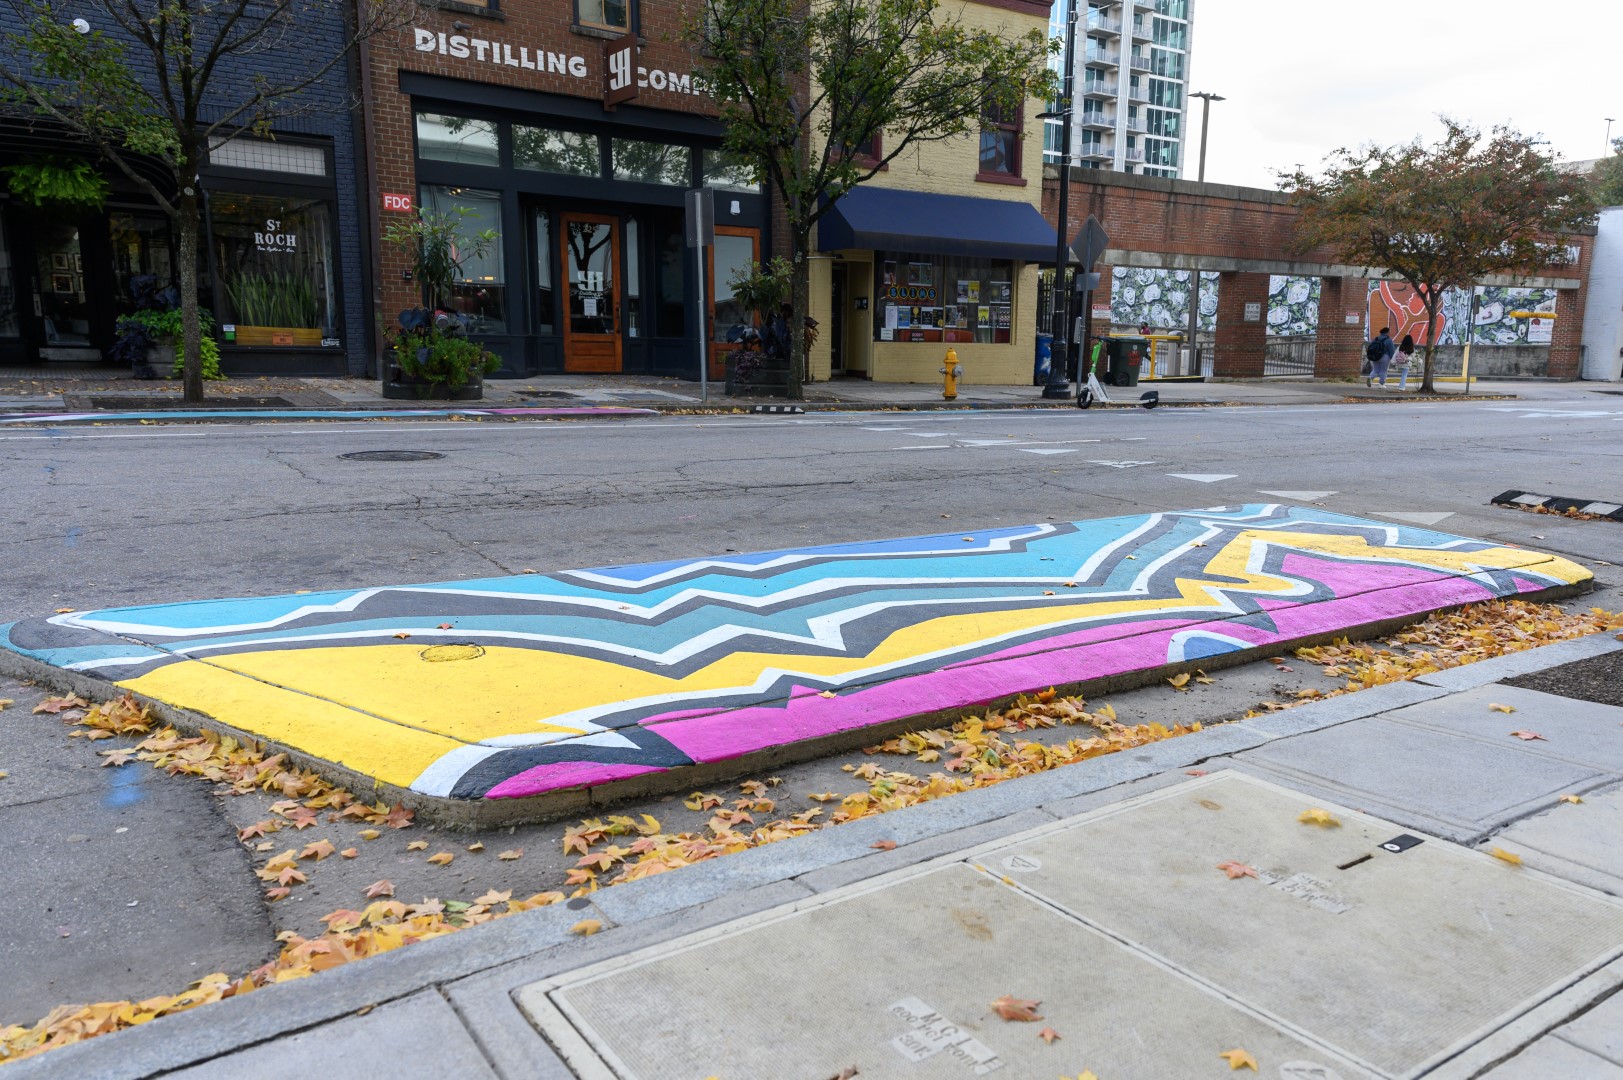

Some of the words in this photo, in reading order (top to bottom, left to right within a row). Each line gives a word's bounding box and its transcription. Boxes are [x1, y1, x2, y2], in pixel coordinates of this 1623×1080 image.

[414, 28, 587, 78] DISTILLING
[637, 66, 758, 102] COMP
[384, 195, 410, 209] FDC
[253, 232, 297, 247] ROCH
